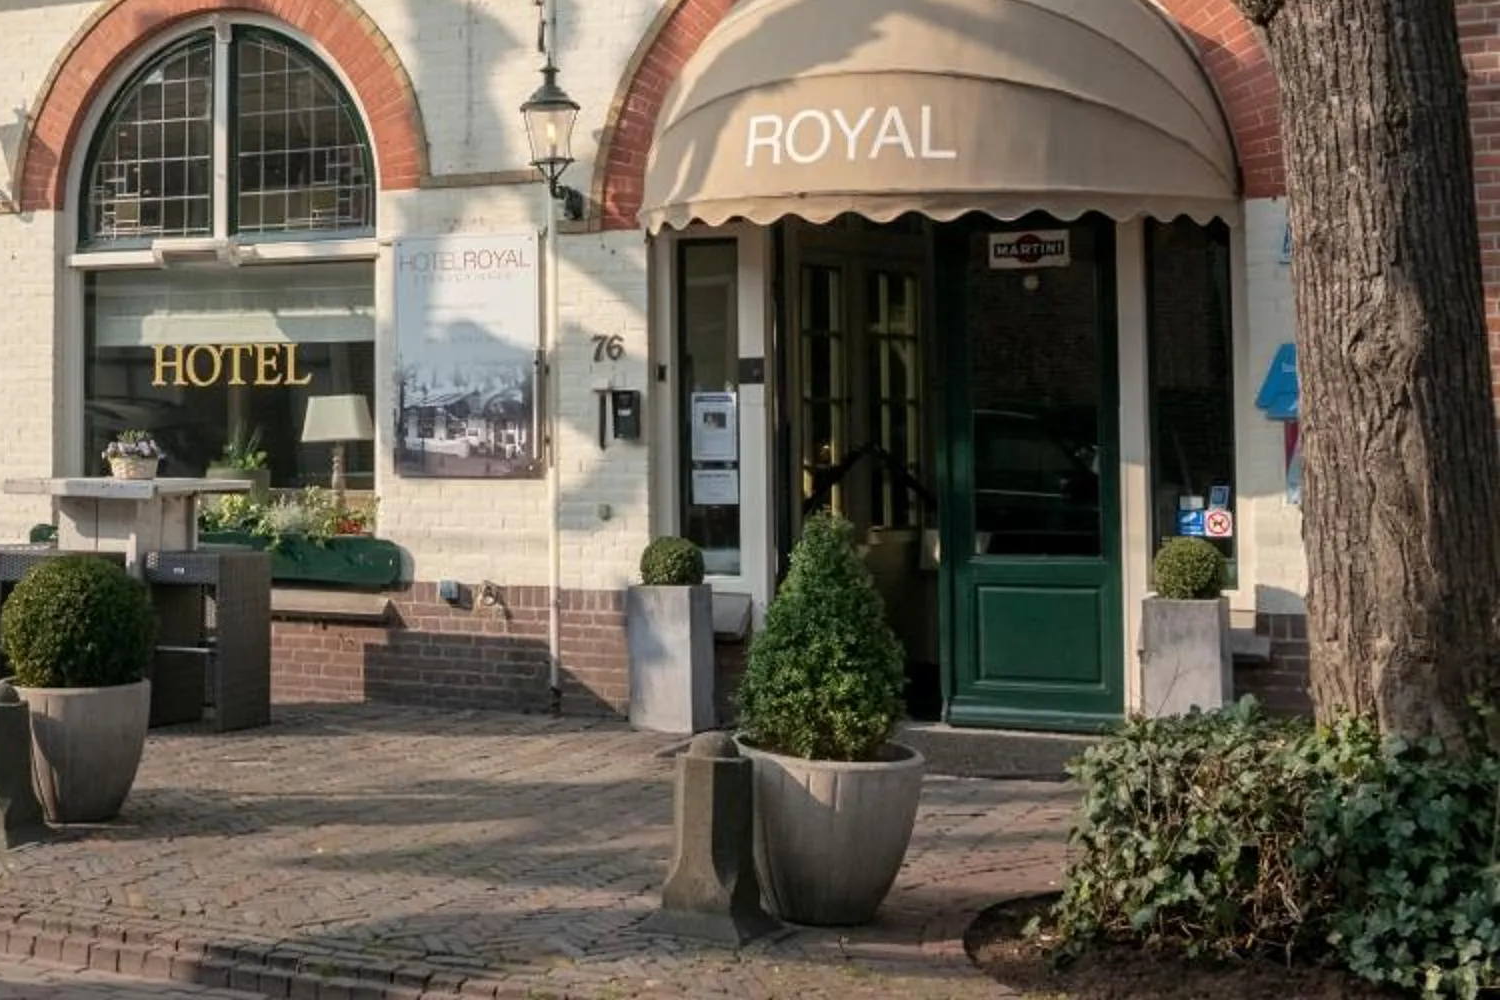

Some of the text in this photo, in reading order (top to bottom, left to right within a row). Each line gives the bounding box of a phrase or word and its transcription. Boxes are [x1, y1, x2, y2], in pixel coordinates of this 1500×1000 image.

[745, 105, 957, 167] ROYAL
[995, 241, 1064, 257] MARTINI
[151, 343, 312, 388] HOTEL
[592, 334, 624, 363] 76
